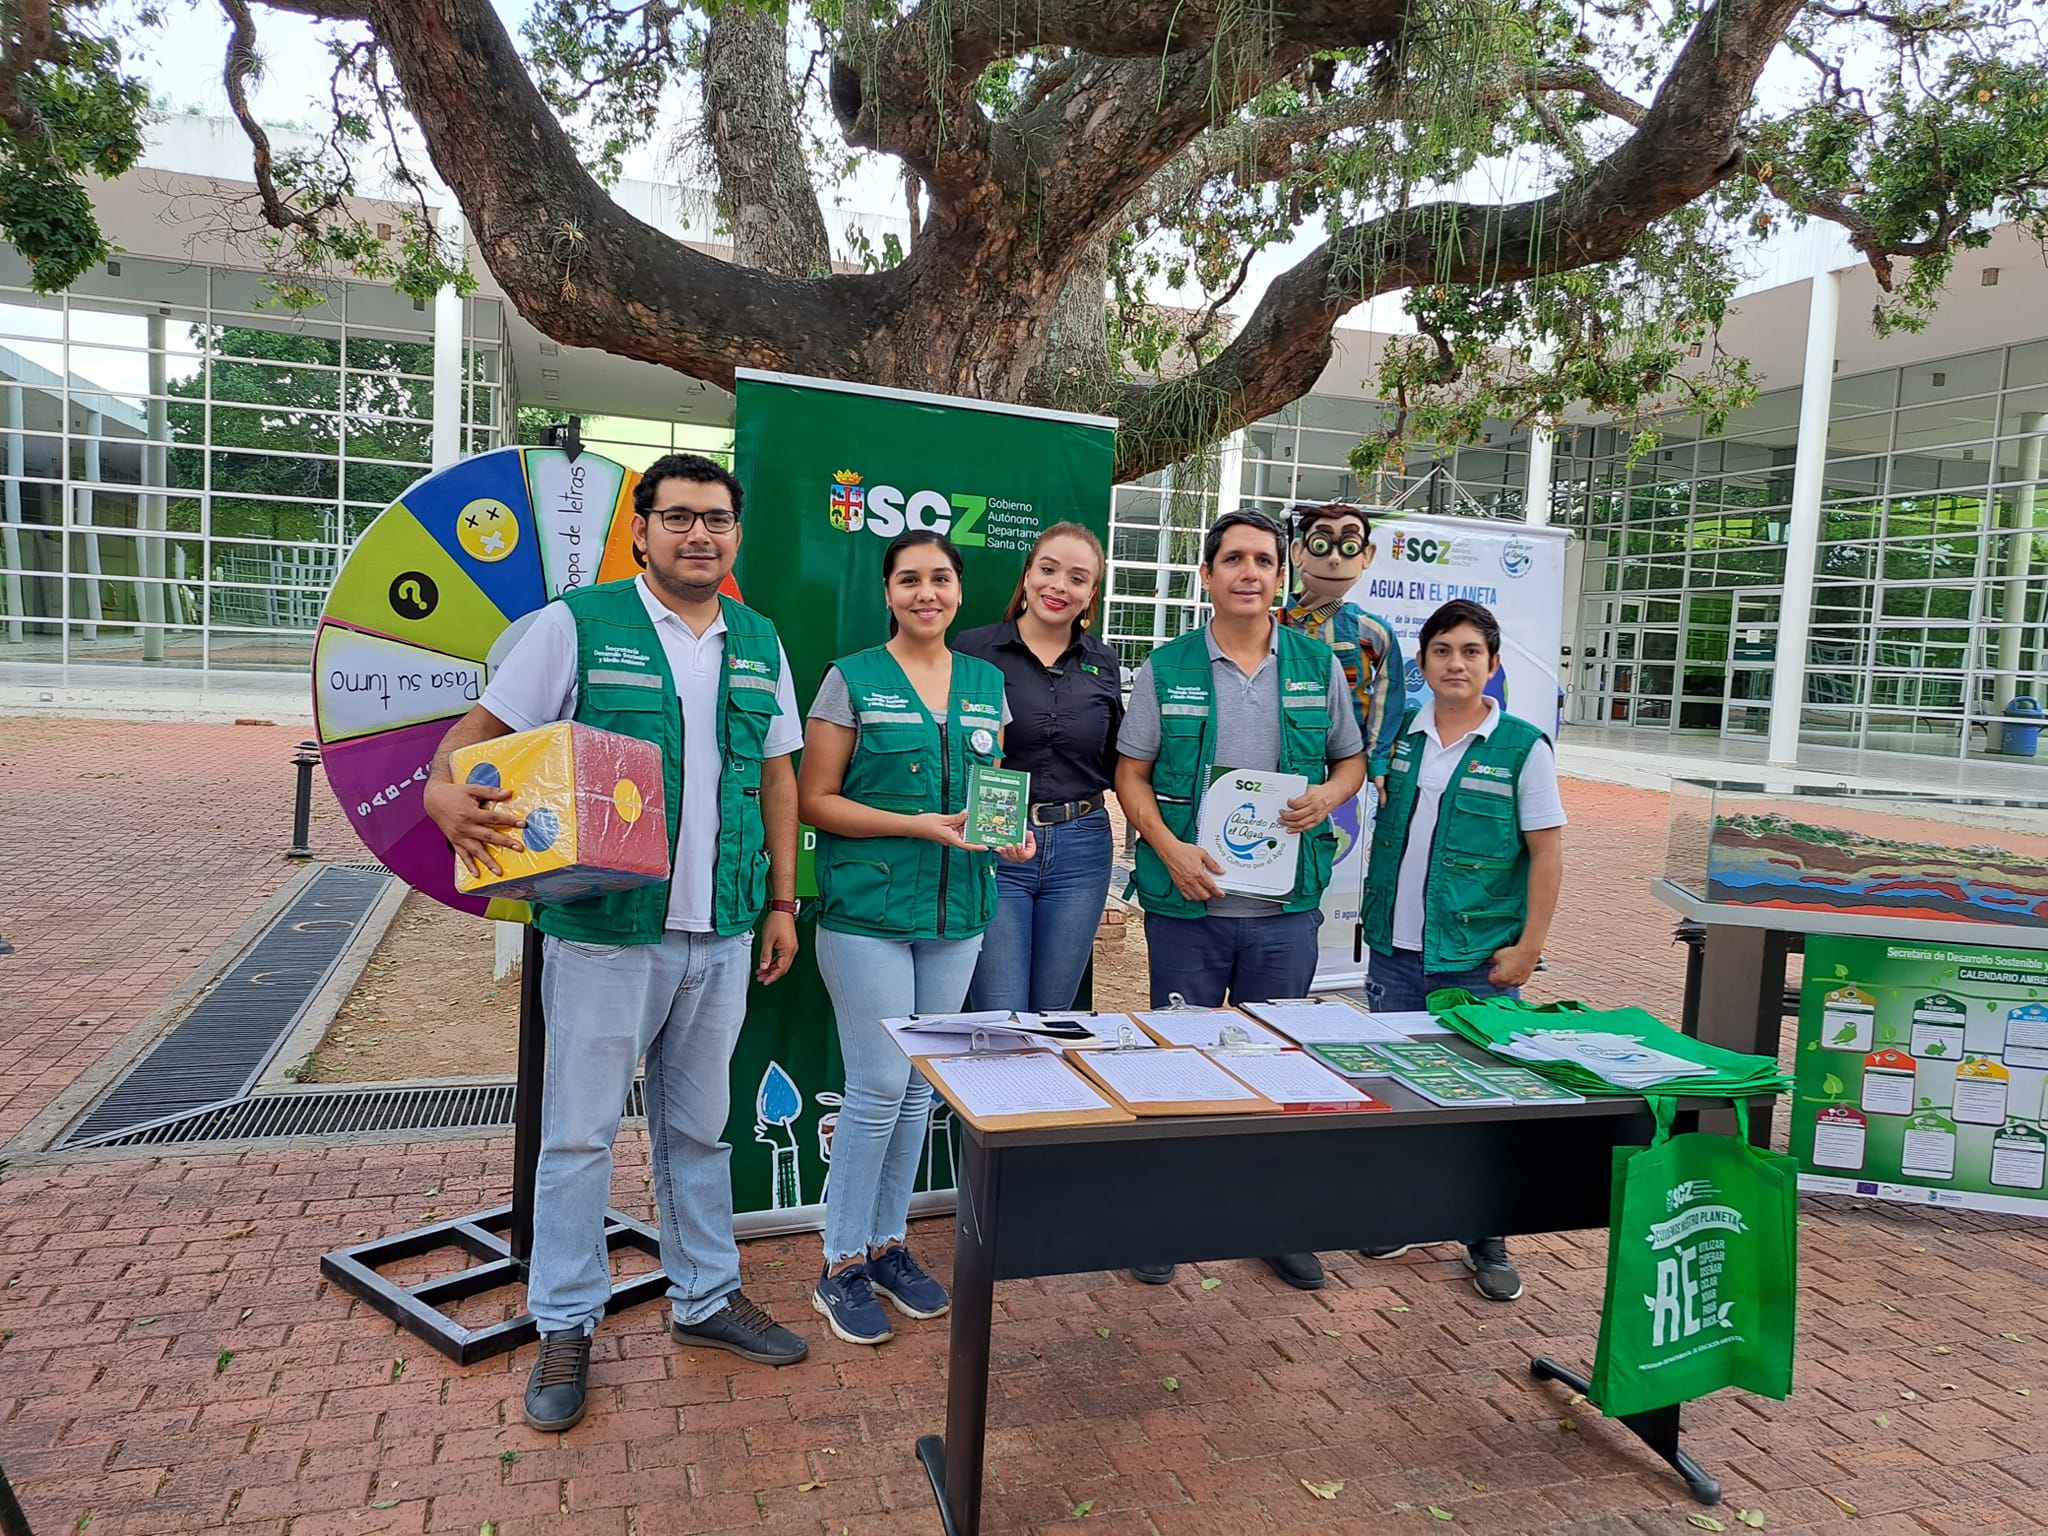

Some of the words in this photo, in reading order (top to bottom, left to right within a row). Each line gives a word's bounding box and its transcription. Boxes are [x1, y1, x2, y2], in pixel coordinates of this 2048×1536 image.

[557, 466, 586, 514] letras
[988, 497, 1033, 513] Gobierno
[866, 484, 987, 547] SCZ
[987, 511, 1039, 527] Autónomo
[558, 525, 581, 545] de
[987, 523, 1042, 539] Departame
[987, 536, 1016, 550] Santa
[1017, 540, 1036, 552] Cru
[1406, 537, 1452, 565] SCZ
[1369, 579, 1404, 599] AGUA
[1409, 582, 1425, 600] EN
[1429, 583, 1443, 602] EL
[330, 670, 391, 711] turno
[397, 673, 422, 692] su
[431, 670, 481, 701] Pasa
[1235, 779, 1263, 793] SCZ
[1230, 812, 1268, 828] Acuerdo
[1228, 826, 1238, 836] el
[1239, 825, 1264, 840] Agua
[1933, 951, 1946, 961] de
[1947, 952, 1994, 966] Desarrollo
[1995, 955, 2043, 969] Sostenible
[1959, 969, 2018, 982] CALENDARIO
[2019, 974, 2048, 986] AMBIE
[1700, 1210, 1738, 1227] PLANETA
